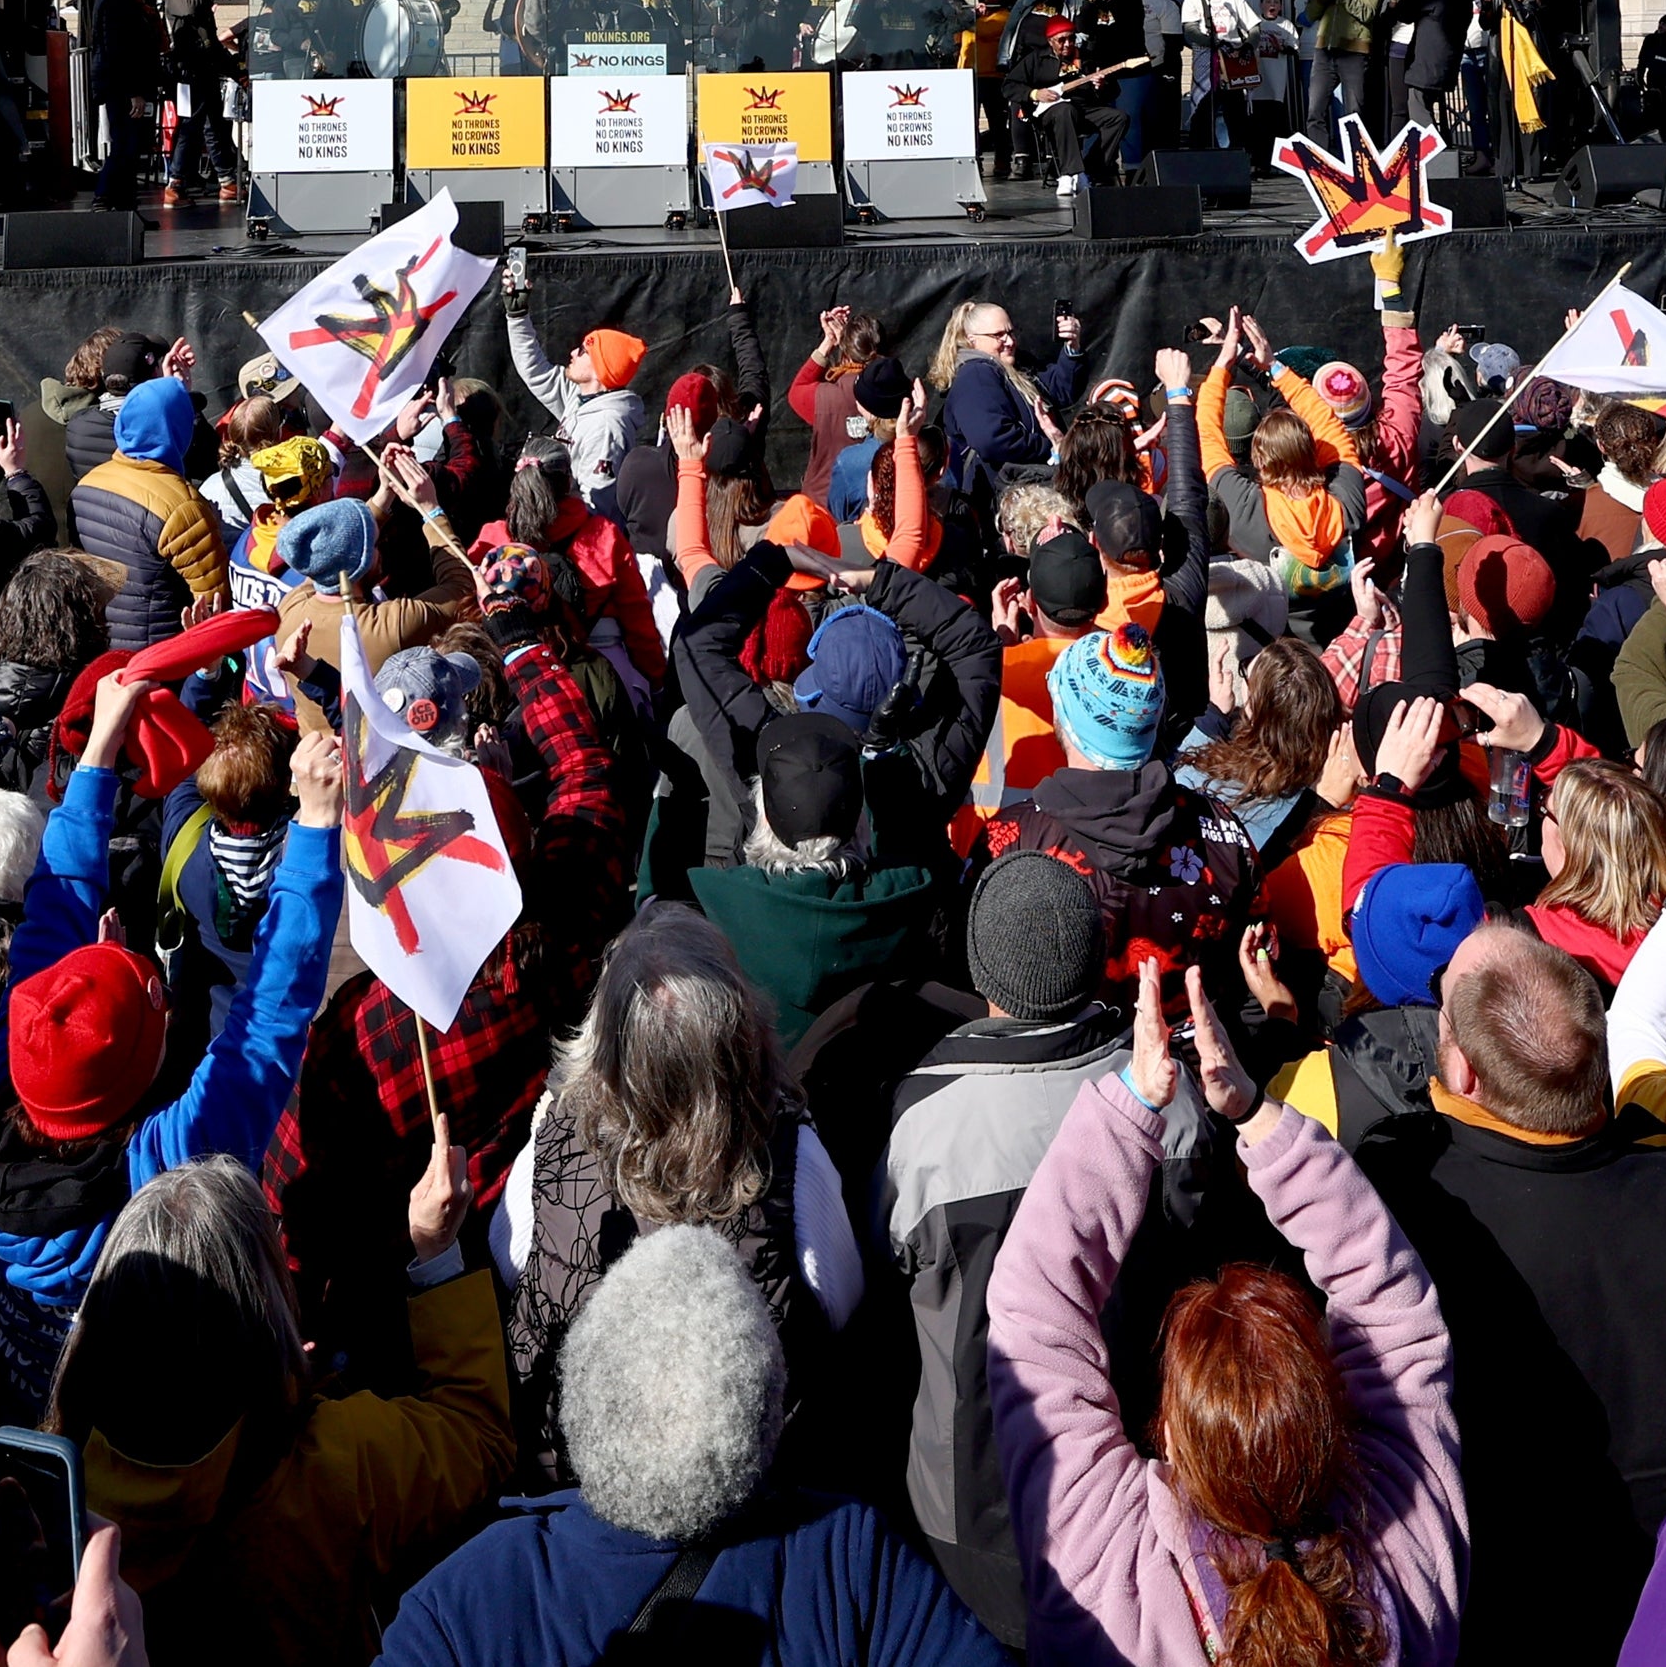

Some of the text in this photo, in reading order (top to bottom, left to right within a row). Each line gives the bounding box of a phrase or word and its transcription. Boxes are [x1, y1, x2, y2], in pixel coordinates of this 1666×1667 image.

[584, 32, 650, 43] NOKINGS.ORG
[598, 55, 665, 66] NO KINGS
[741, 115, 788, 124] NO THRONES
[886, 111, 932, 121] NO THRONES
[299, 122, 347, 132] NO THRONES
[452, 119, 500, 129] NO THRONES
[596, 118, 643, 127] NO THRONES
[887, 123, 933, 132] NO CROWNS
[452, 130, 500, 141] NO CROWNS
[596, 129, 643, 139] NO CROWNS
[741, 126, 788, 135] NO CROWNS
[299, 134, 347, 144] NO CROWNS
[887, 134, 933, 146] NO KINGS
[299, 146, 347, 158] NO KINGS
[452, 142, 500, 155] NO KINGS
[596, 141, 643, 153] NO KINGS
[413, 703, 431, 715] ICE
[412, 712, 435, 725] OUT
[1199, 816, 1218, 830] ST.
[1201, 828, 1223, 842] PIGS
